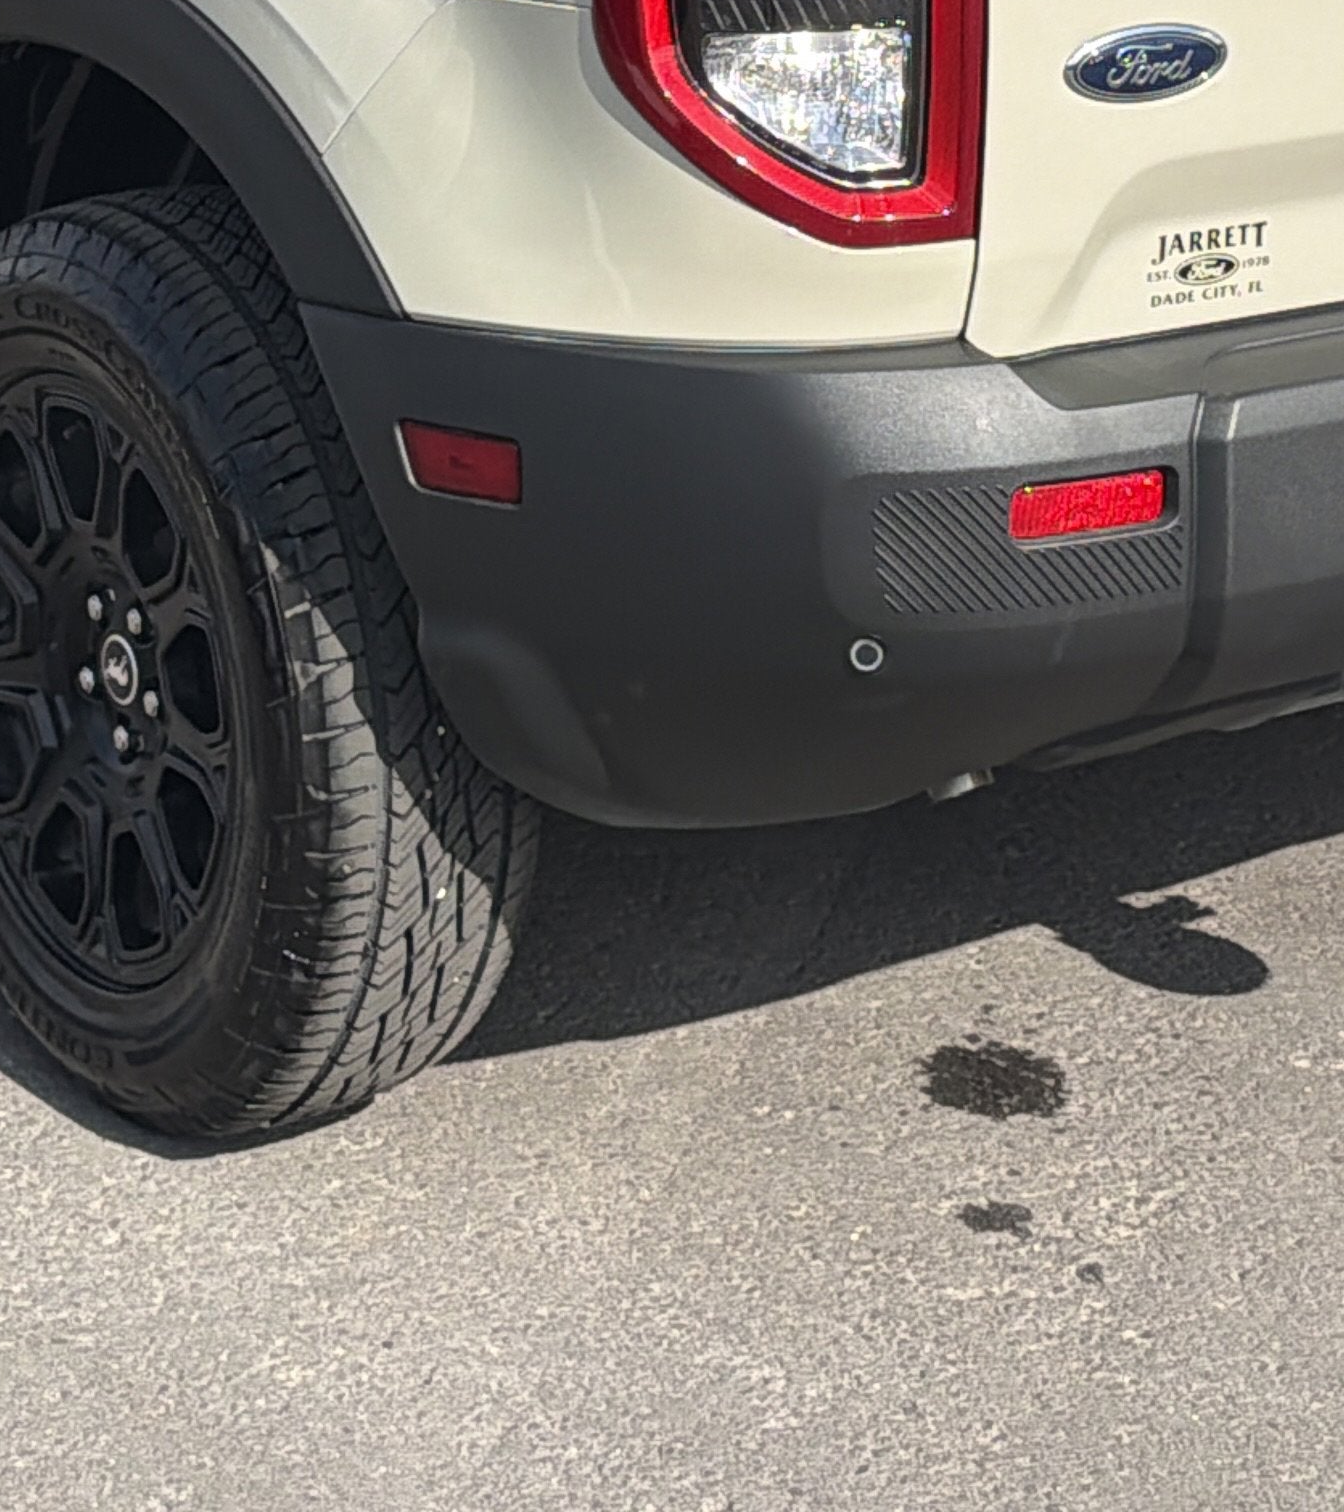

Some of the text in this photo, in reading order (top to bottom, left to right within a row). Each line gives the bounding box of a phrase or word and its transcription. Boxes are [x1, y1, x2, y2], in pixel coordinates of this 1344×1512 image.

[1106, 42, 1194, 89] Ford
[1150, 220, 1268, 266] JARRETT
[1150, 290, 1195, 308] DADE
[1248, 280, 1264, 294] FL
